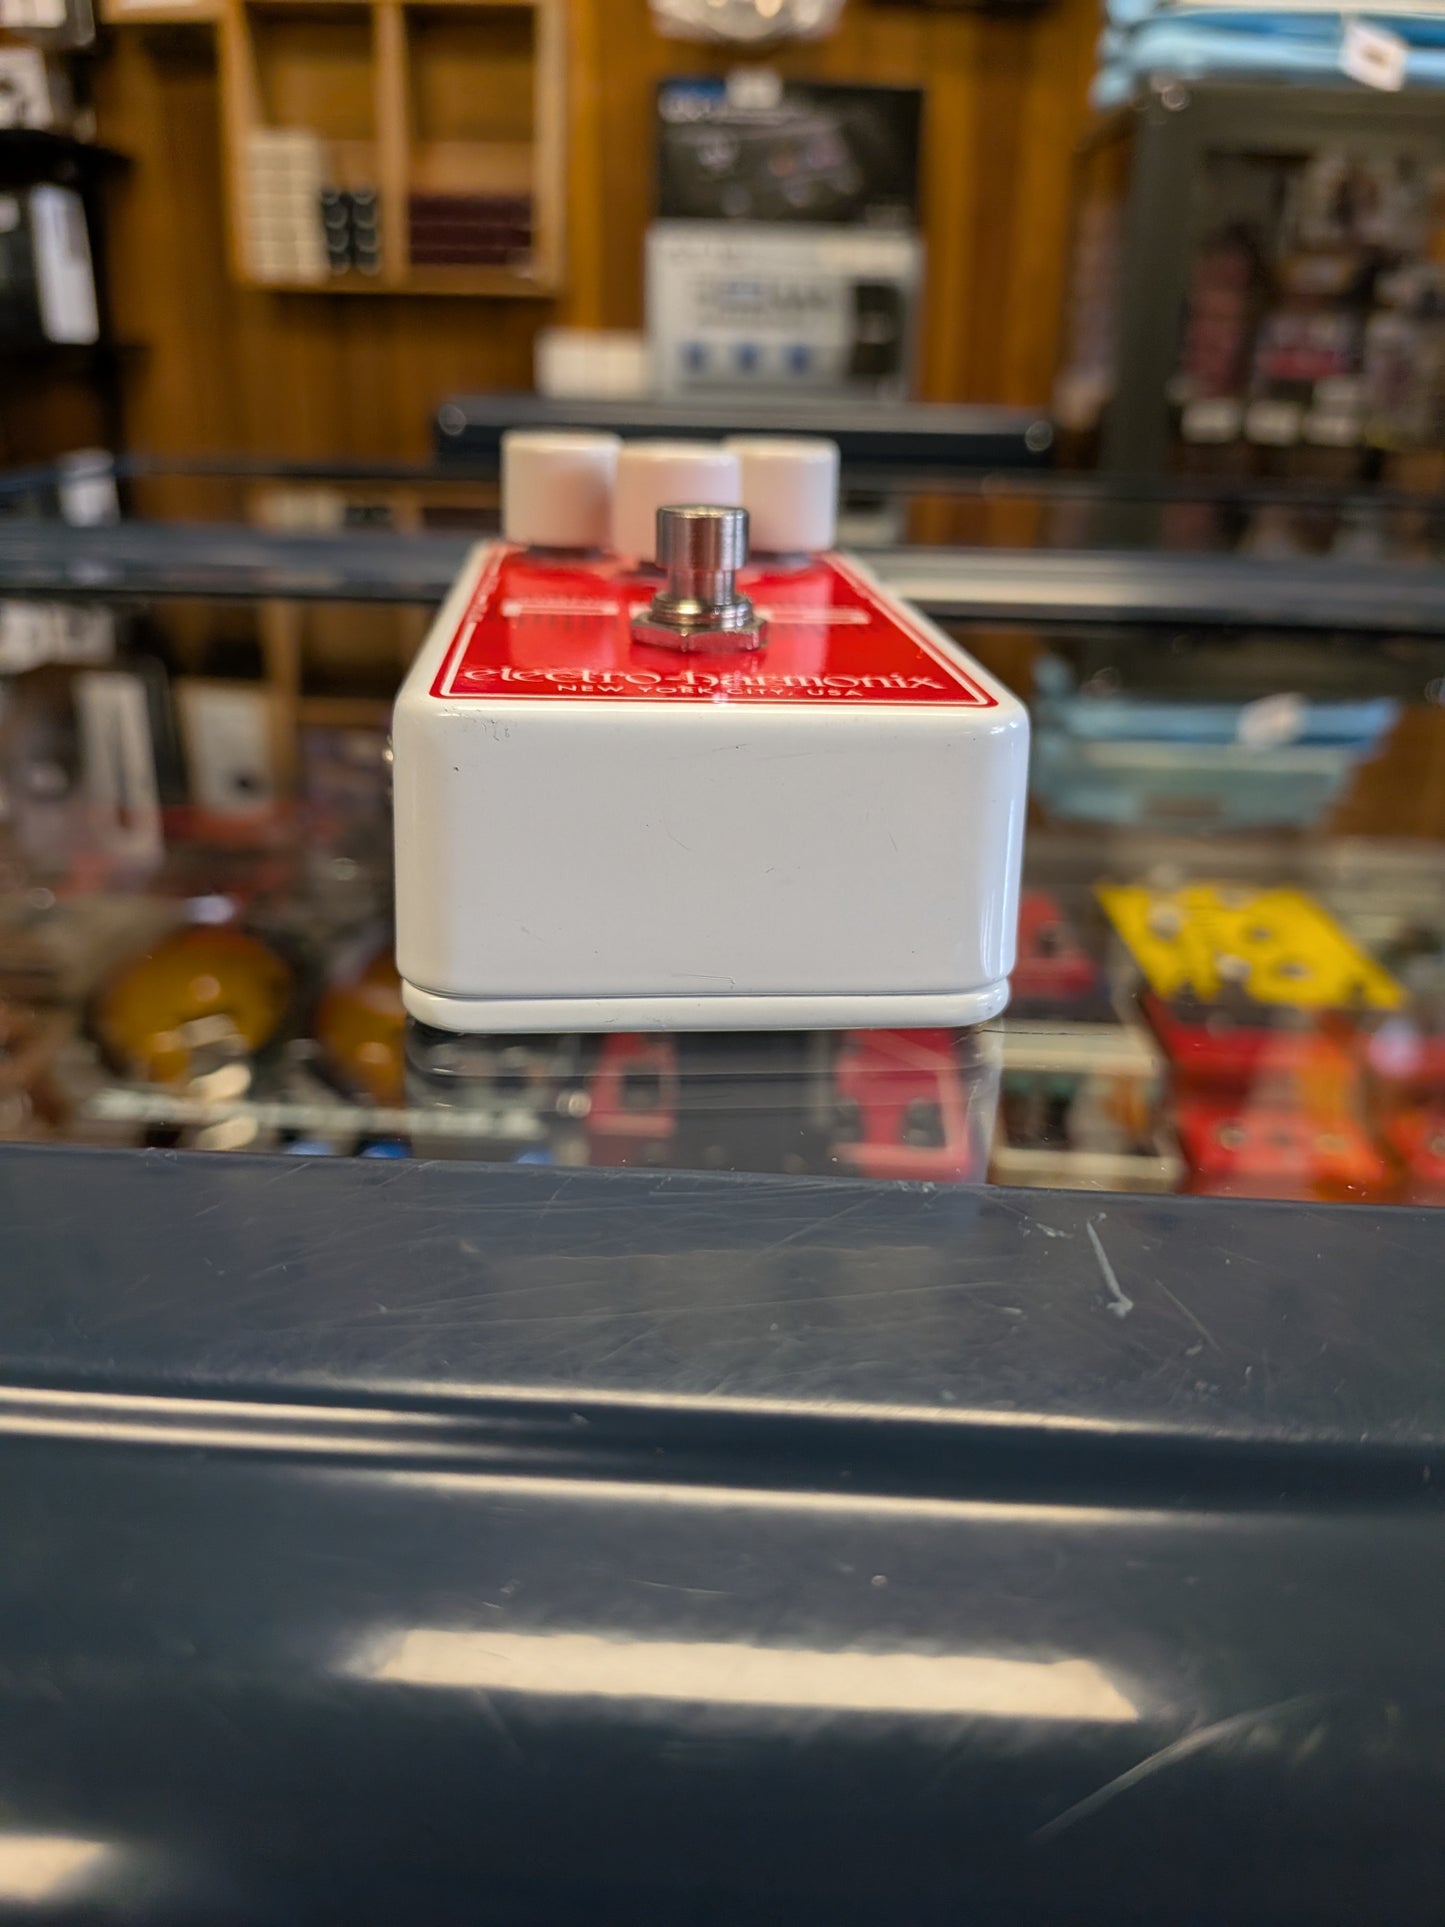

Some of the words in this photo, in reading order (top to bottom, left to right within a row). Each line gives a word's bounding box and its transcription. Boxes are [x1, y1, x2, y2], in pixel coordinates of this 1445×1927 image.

[464, 667, 946, 689] electro-harmonix
[556, 684, 625, 693] NEW
[638, 686, 714, 694] YORK
[806, 688, 864, 697] USA
